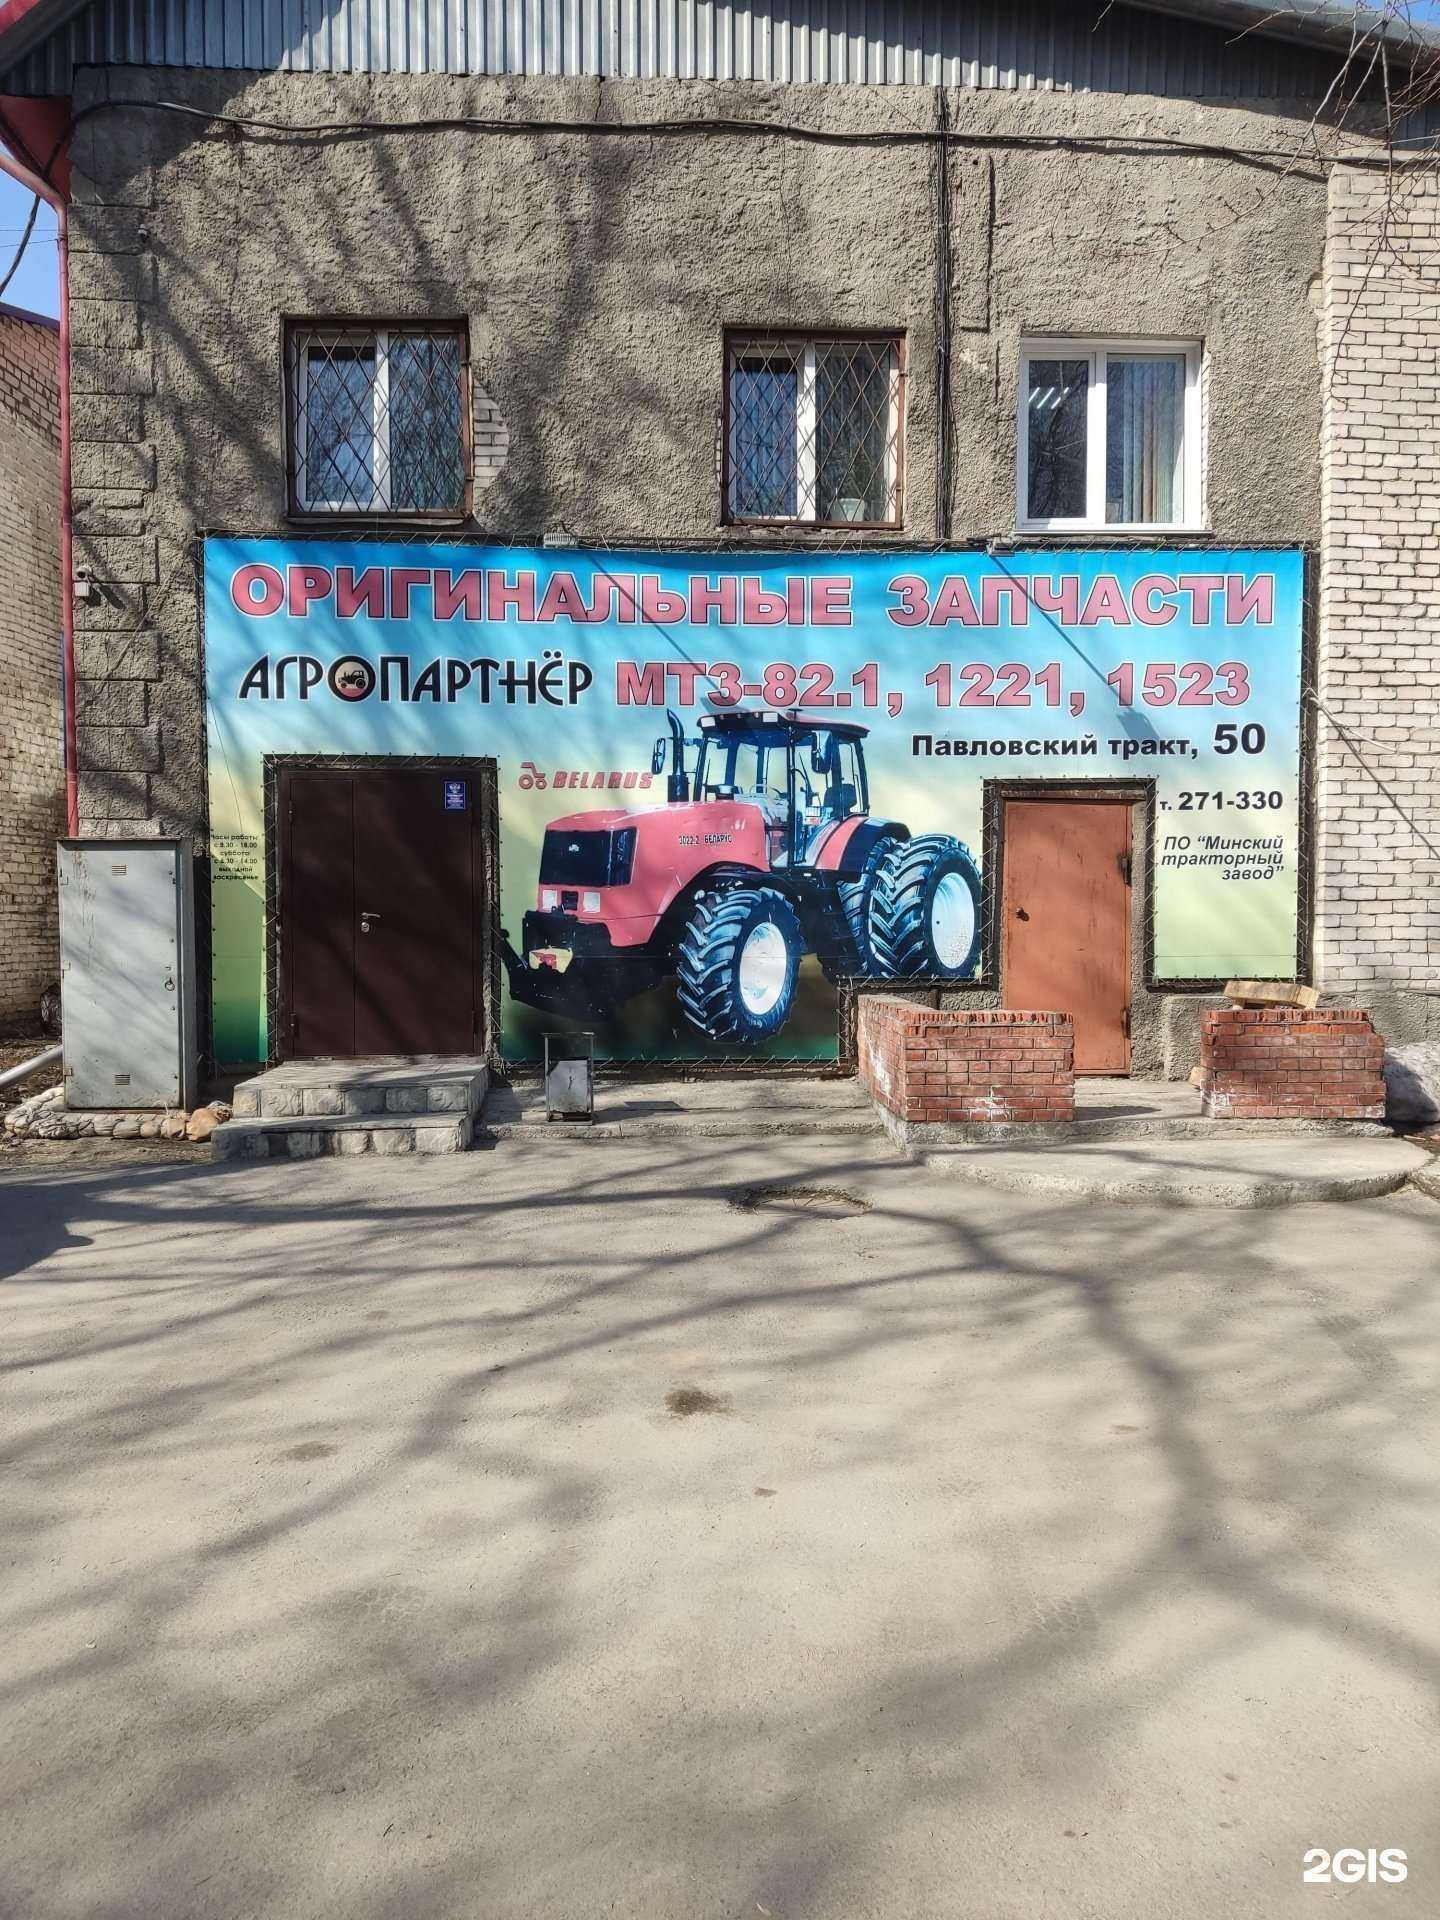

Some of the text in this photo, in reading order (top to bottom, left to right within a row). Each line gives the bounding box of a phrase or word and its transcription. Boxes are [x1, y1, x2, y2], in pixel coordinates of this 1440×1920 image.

[231, 564, 1275, 627] ОРИГИНАЛЬНЫЕ ЗАПЧАСТИ
[239, 650, 593, 706] АГРОПАРТНЁР
[616, 661, 1251, 718] МТЗ-82.1, 1221, 1523
[912, 723, 1267, 760] Павловский тракт, 50
[552, 771, 653, 789] BELARUS
[1178, 791, 1284, 811] 271-330
[1164, 836, 1191, 850] ПО
[1161, 851, 1284, 869] тракторный
